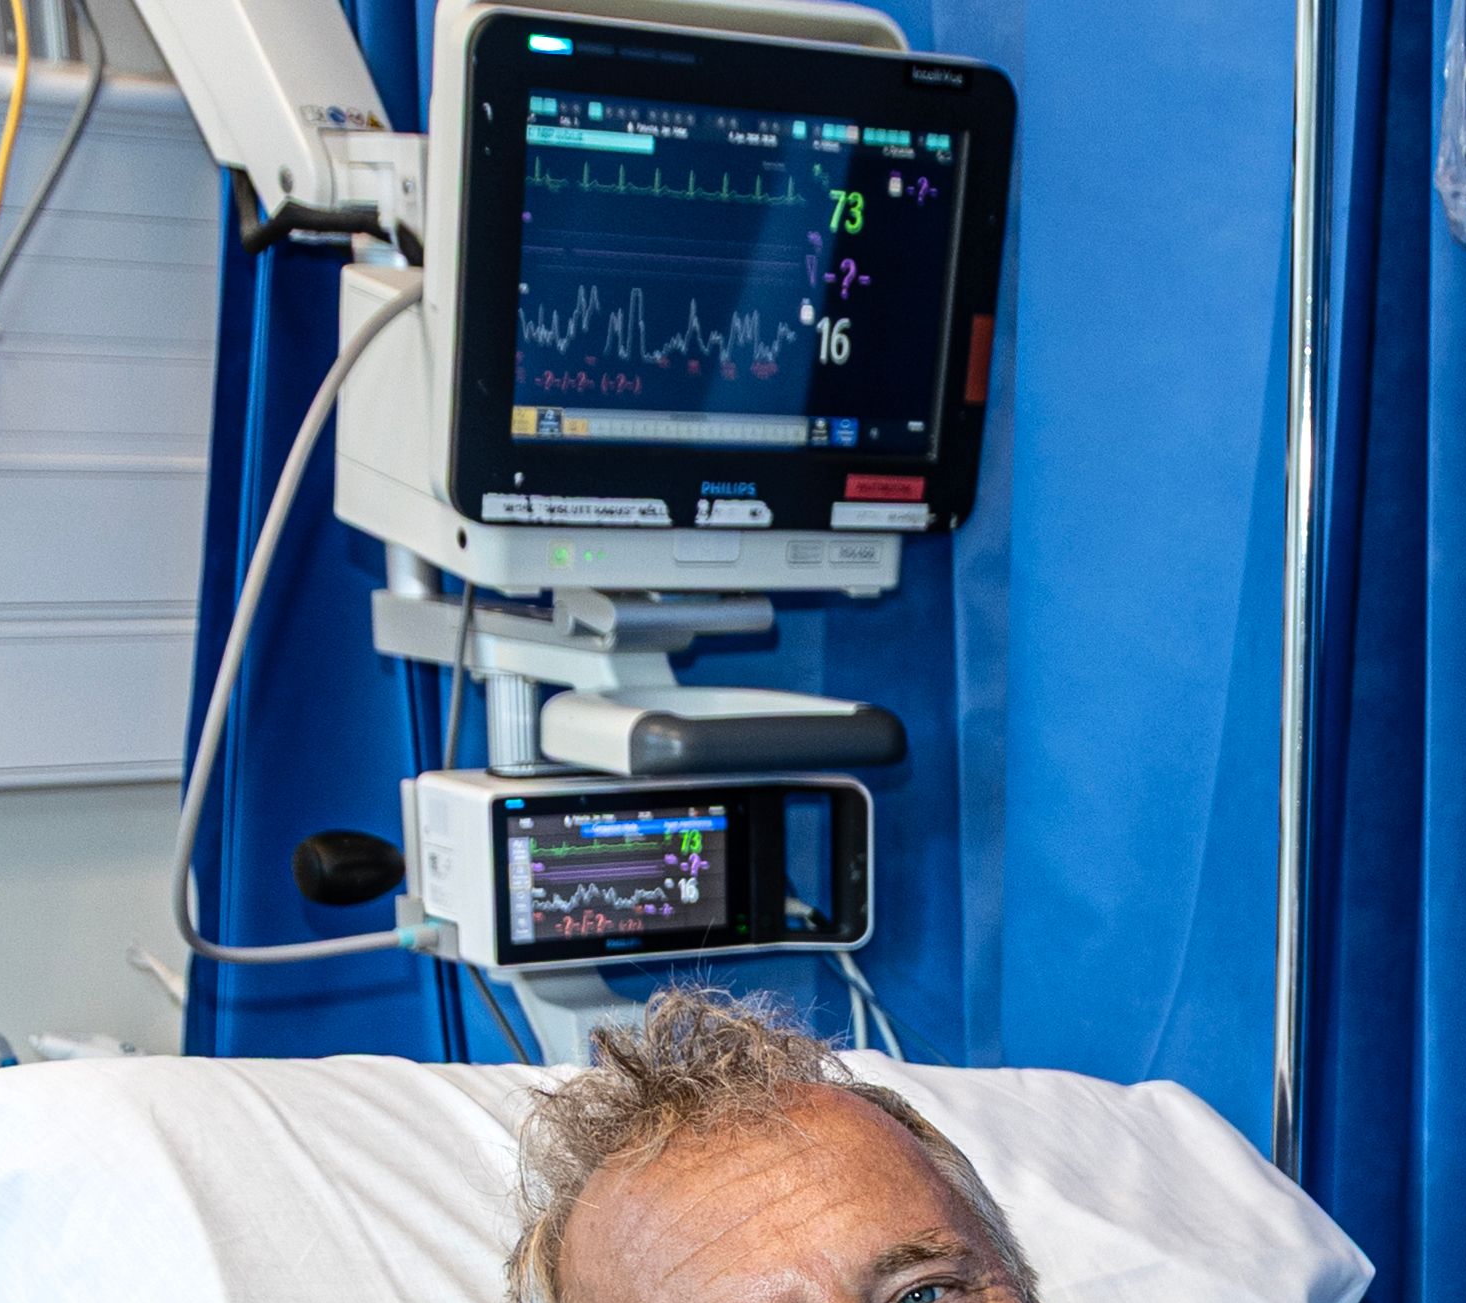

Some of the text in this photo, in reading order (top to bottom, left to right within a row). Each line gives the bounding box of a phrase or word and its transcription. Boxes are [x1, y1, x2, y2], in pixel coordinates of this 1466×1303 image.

[829, 189, 864, 234] 73
[816, 316, 852, 366] 16
[700, 481, 757, 497] PHILIPS
[680, 829, 703, 855] 73
[678, 877, 700, 904] 16
